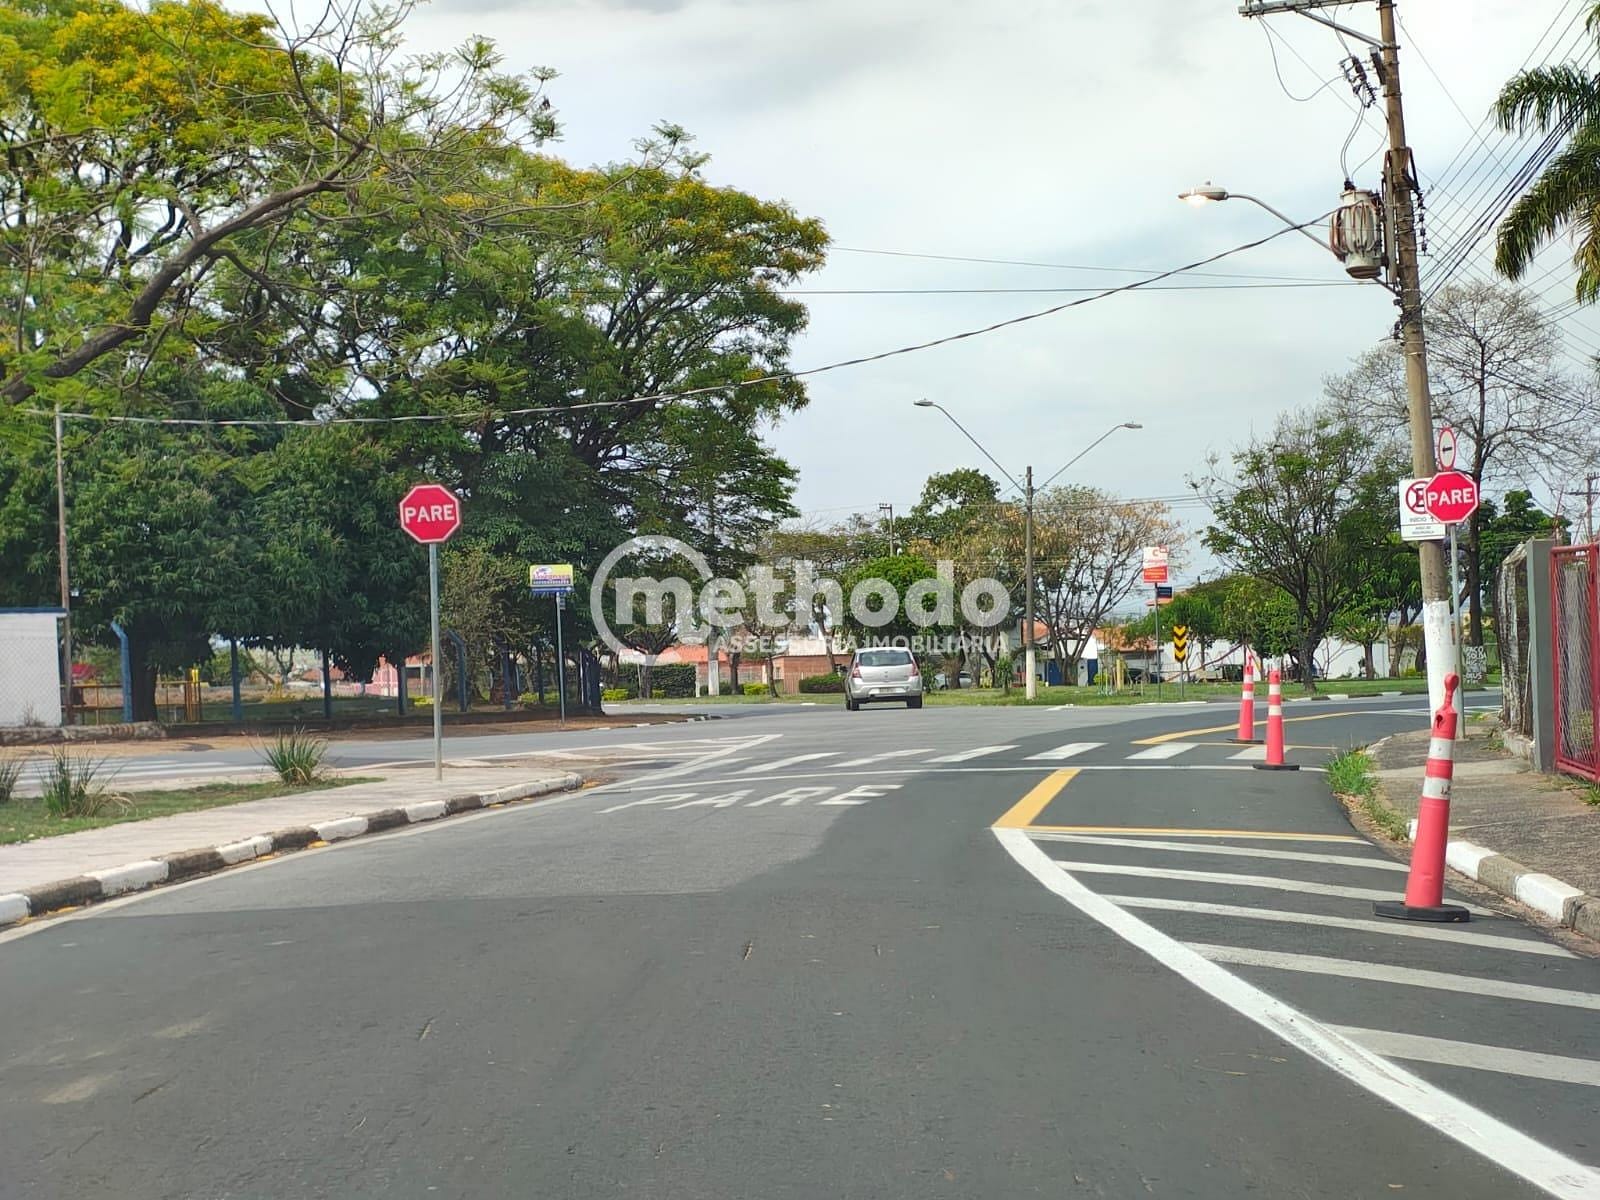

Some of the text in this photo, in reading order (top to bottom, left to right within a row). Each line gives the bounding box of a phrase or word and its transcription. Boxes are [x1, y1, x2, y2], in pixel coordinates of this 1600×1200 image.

[1427, 488, 1474, 507] PARE
[404, 504, 456, 524] PARE
[593, 784, 904, 814] PARE
